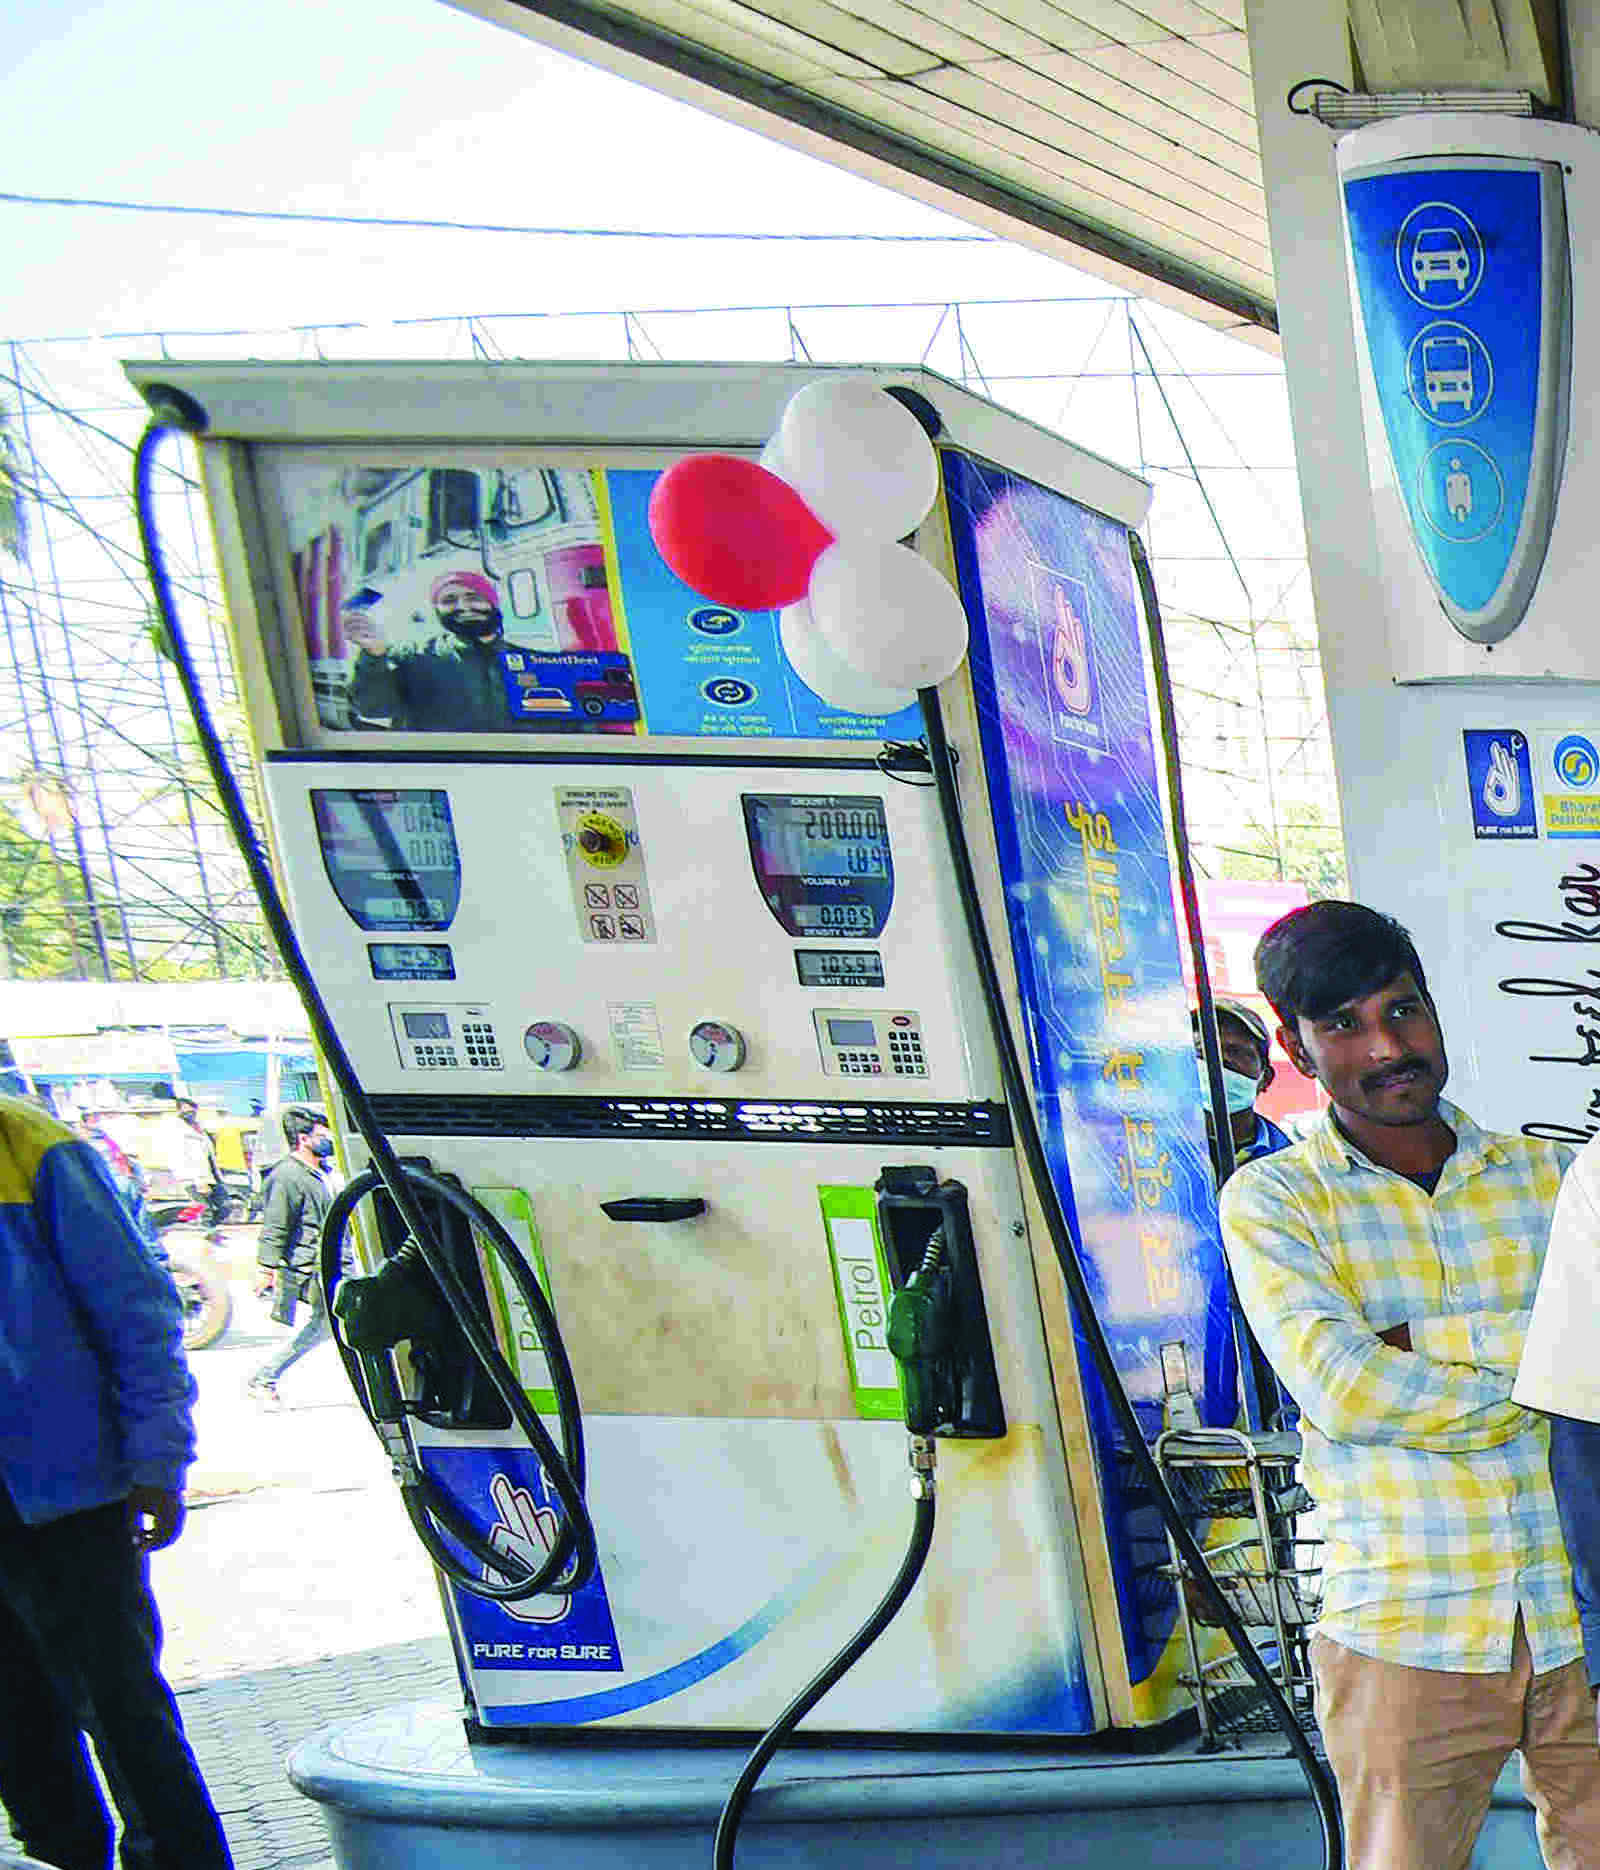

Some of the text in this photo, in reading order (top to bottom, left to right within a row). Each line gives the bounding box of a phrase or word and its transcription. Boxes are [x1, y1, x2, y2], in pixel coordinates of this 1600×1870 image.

[839, 1256, 888, 1353] Petrol
[474, 1643, 612, 1660] PURE FOR SURE
